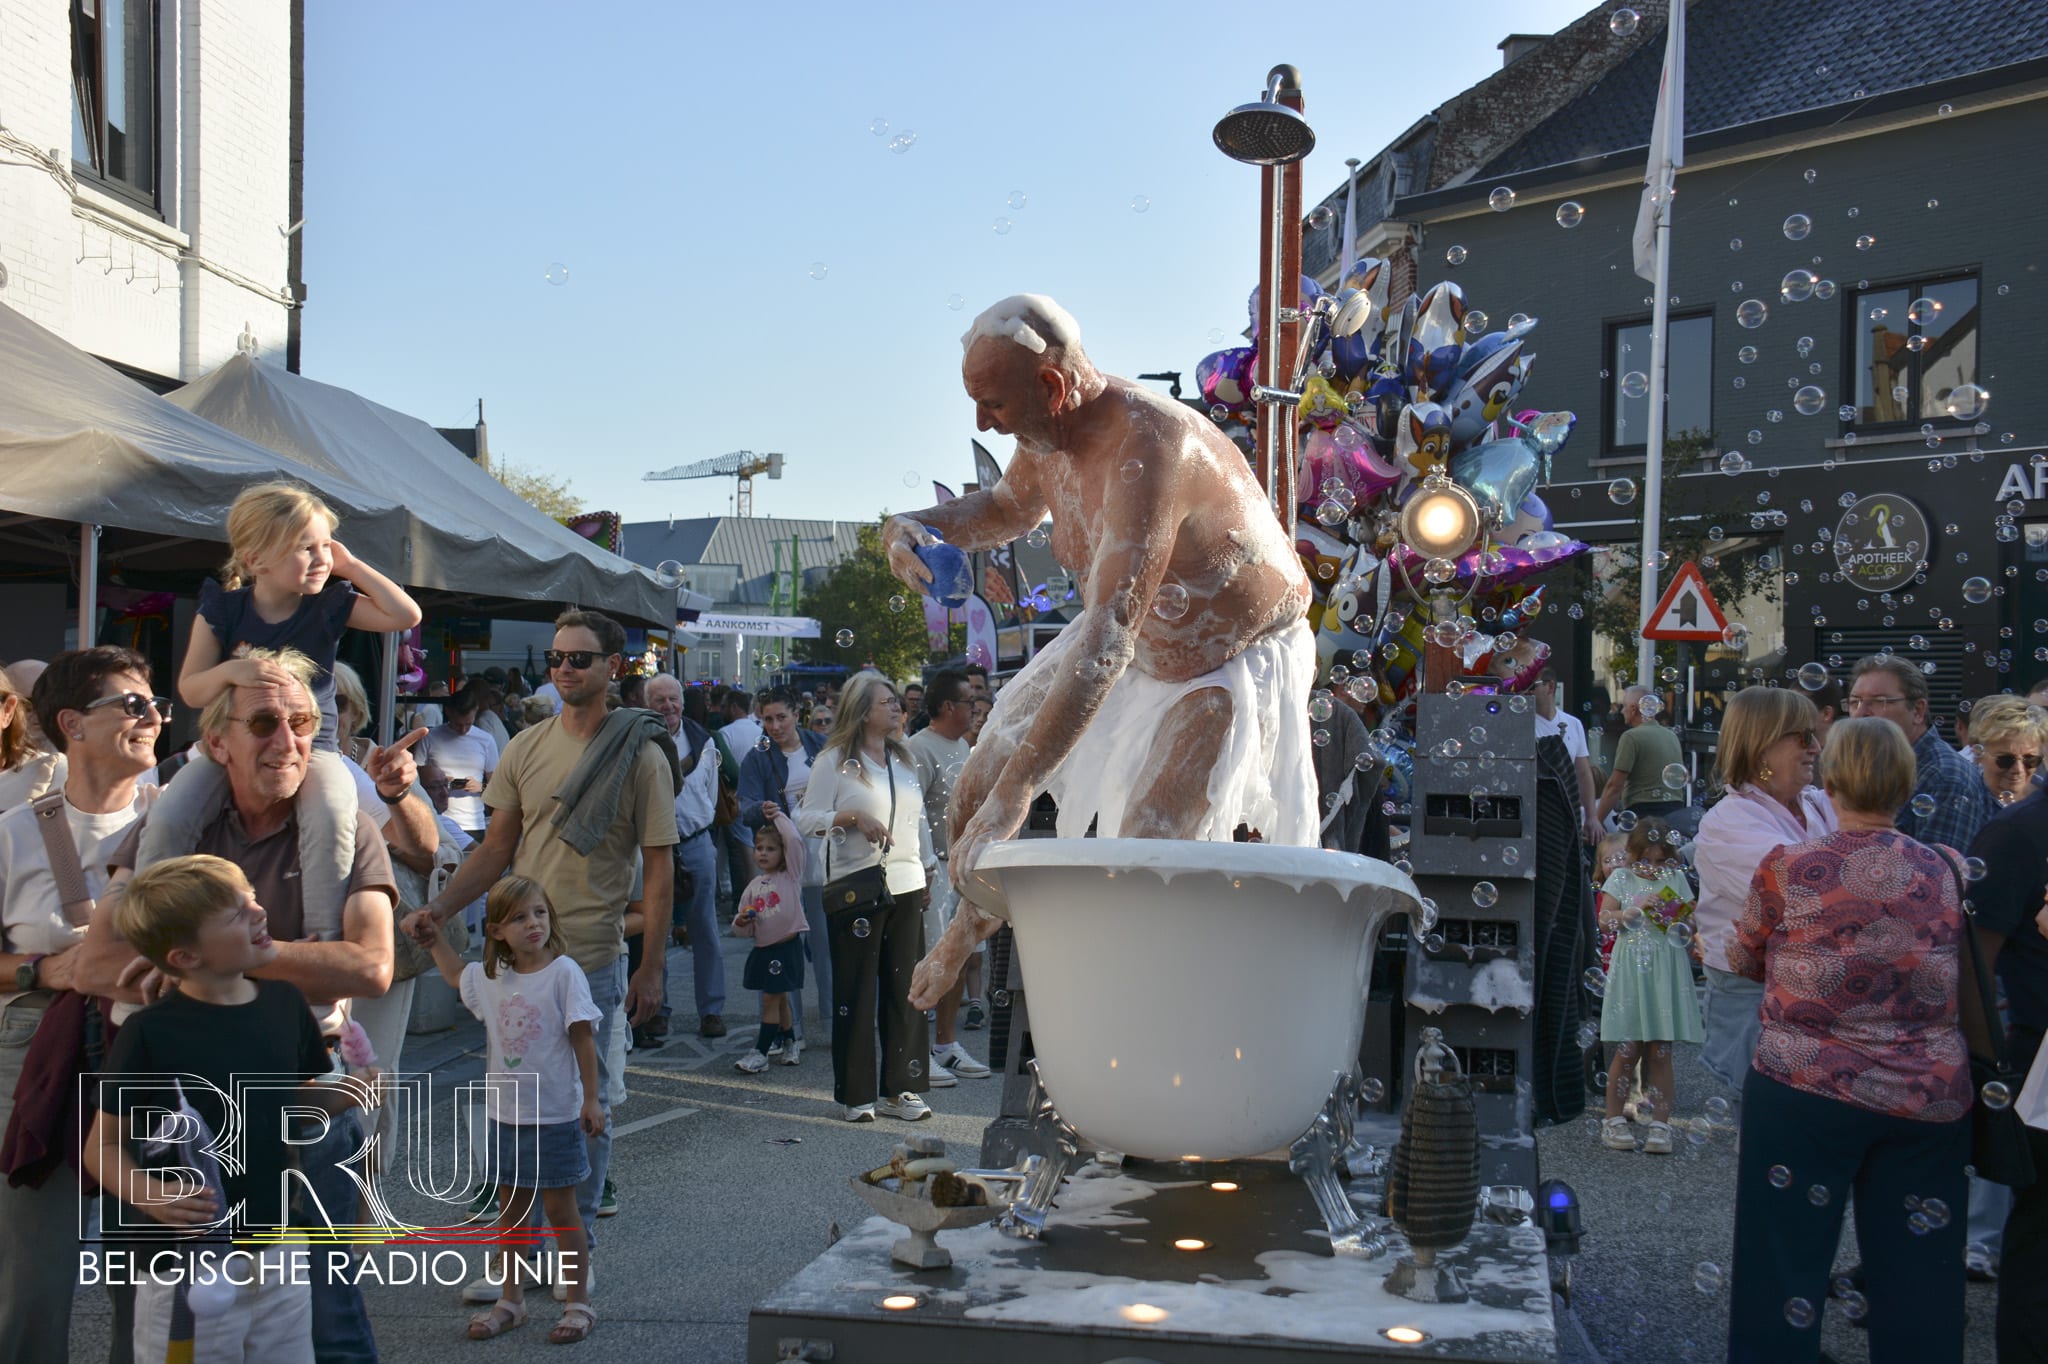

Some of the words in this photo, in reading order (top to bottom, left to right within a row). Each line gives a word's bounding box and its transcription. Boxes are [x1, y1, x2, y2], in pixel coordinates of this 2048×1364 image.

[1849, 552, 1912, 564] APOTHEEK
[1858, 564, 1902, 575] ACCOU
[706, 619, 770, 631] AANKOMST
